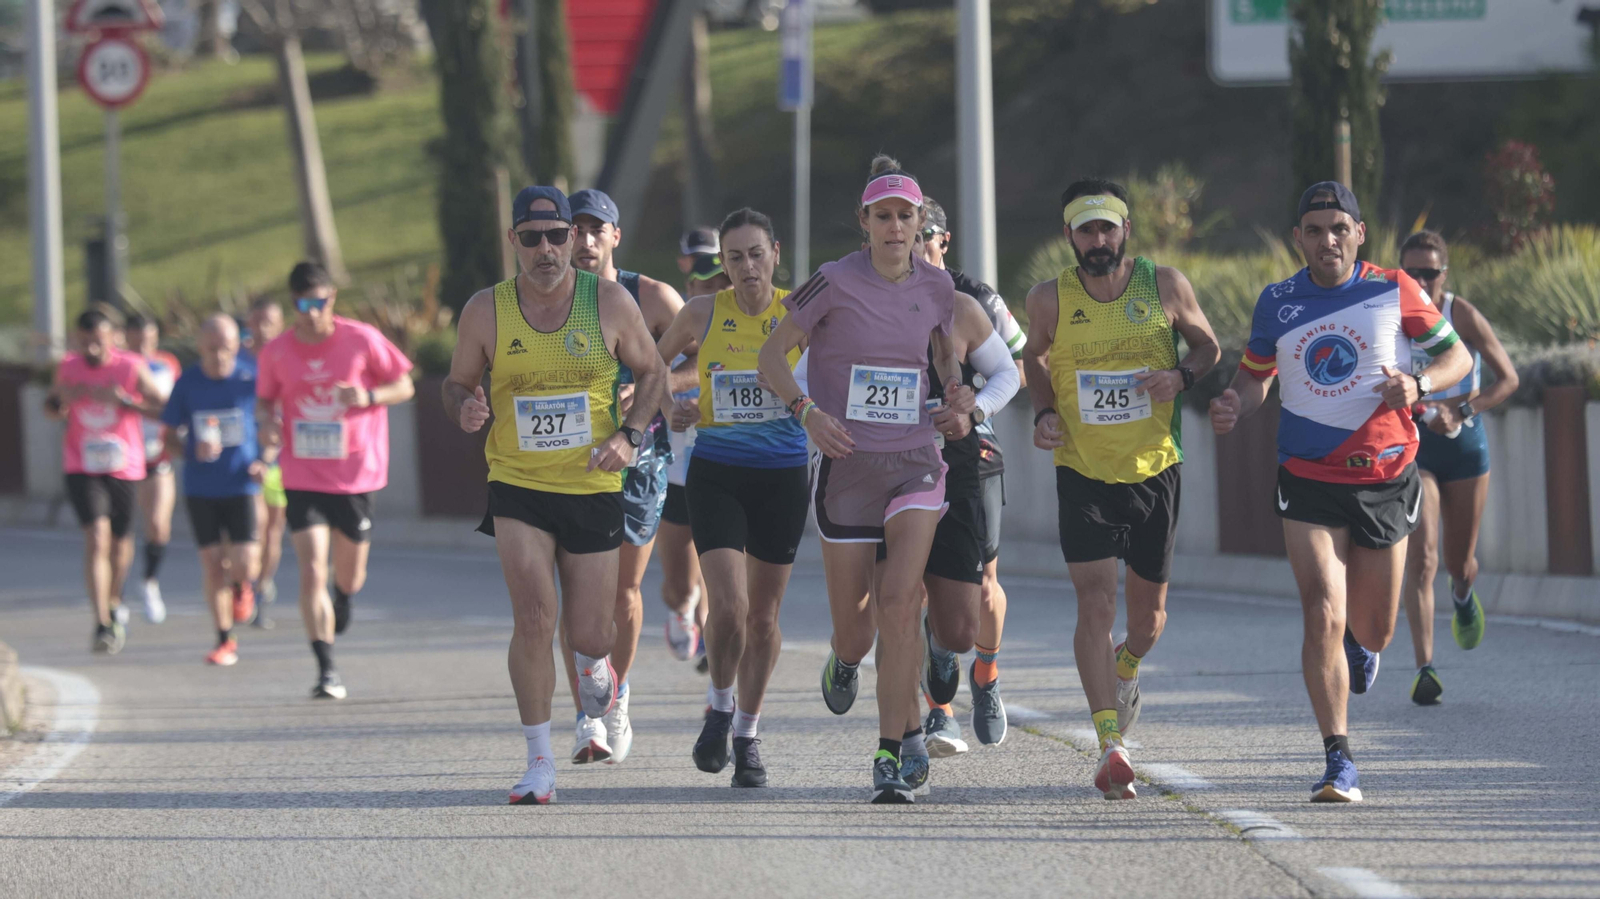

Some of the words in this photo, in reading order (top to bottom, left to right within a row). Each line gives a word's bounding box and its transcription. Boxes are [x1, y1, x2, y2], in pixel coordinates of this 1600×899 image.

[1072, 335, 1153, 358] RUTEROS
[1294, 323, 1335, 360] RUNNING
[1343, 325, 1368, 351] TEAM
[510, 370, 593, 388] RUTEROS
[1098, 376, 1128, 385] MARATÓN
[1304, 374, 1363, 397] ALGECIRAS
[729, 387, 763, 407] 188
[865, 384, 899, 407] 231
[1094, 389, 1130, 409] 245
[535, 402, 566, 411] MARATÓN
[866, 410, 899, 420] EVOS
[531, 413, 567, 435] 237
[1097, 413, 1131, 421] EVOS
[535, 439, 570, 448] EVOS
